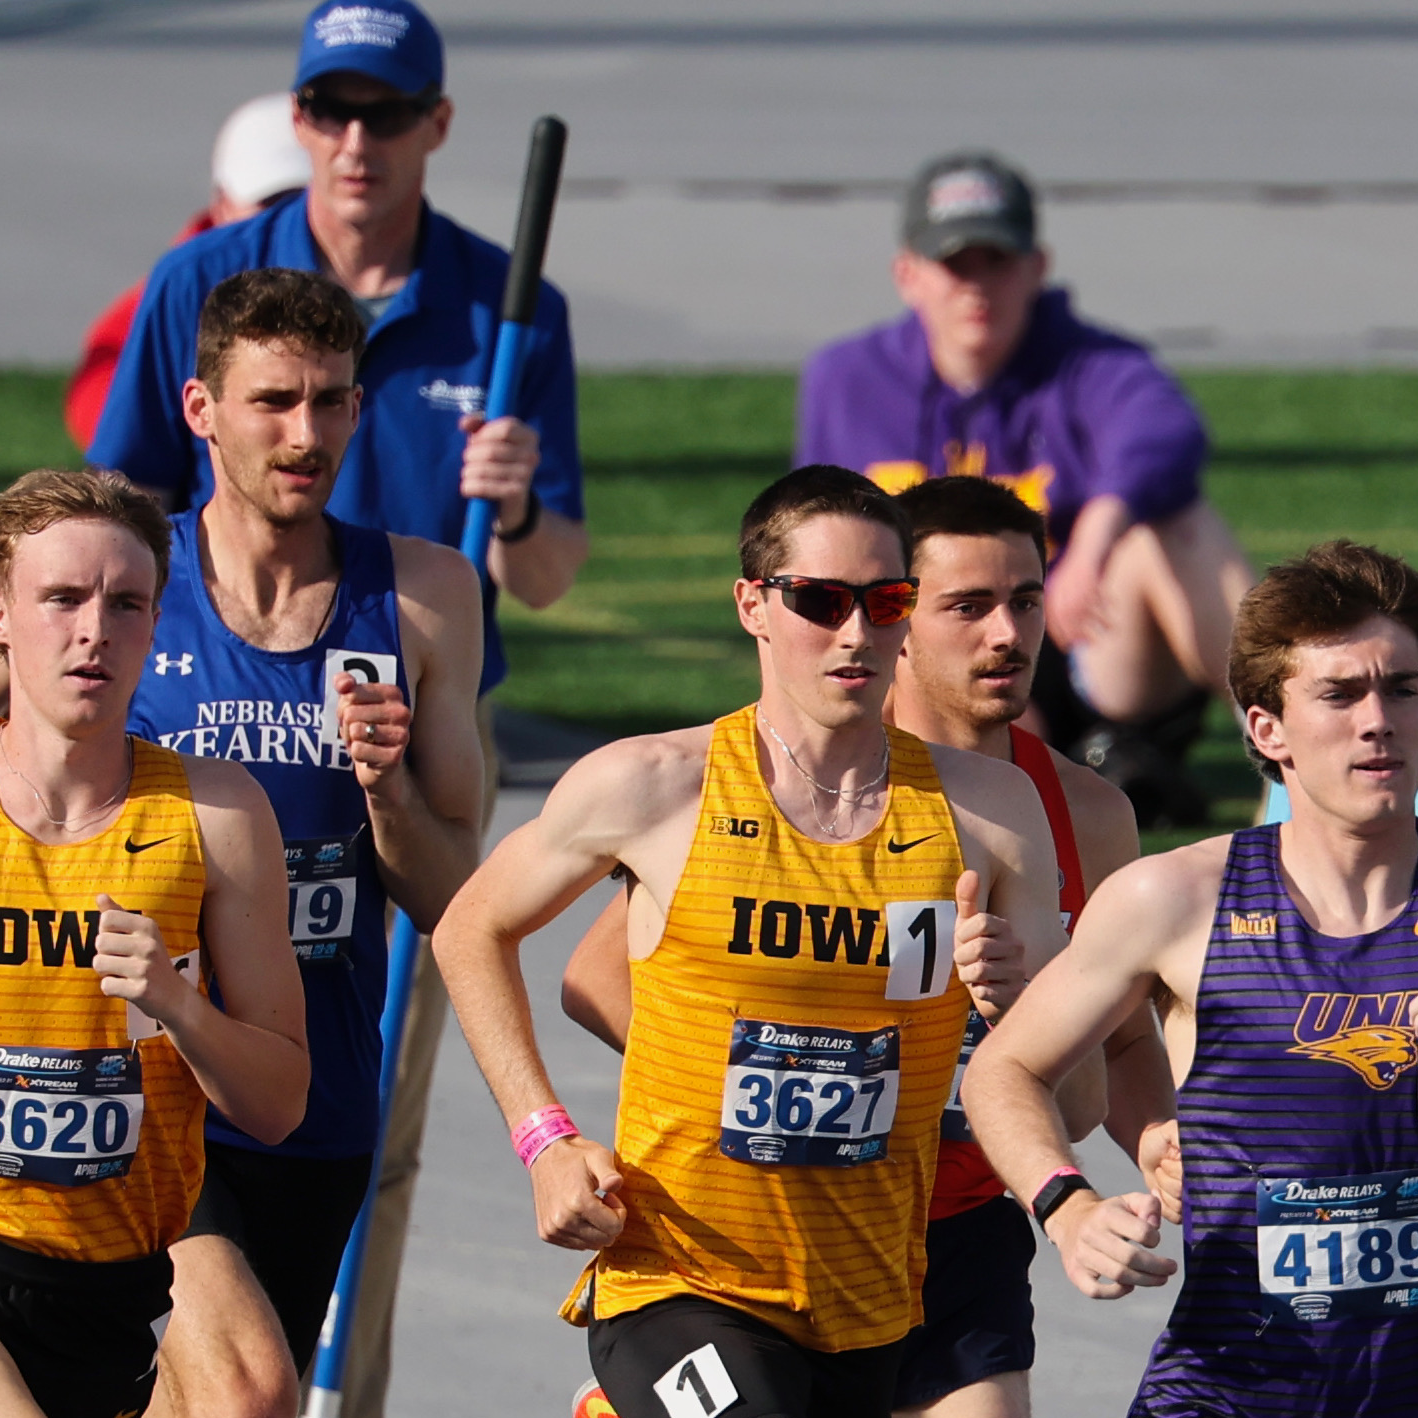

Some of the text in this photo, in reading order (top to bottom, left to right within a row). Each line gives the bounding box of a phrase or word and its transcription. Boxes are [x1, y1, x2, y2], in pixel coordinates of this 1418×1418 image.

[1231, 914, 1278, 935] VALLEY
[728, 896, 936, 994] IOW 1
[758, 1026, 809, 1047] Drake
[810, 1037, 853, 1050] RELAYS
[41, 1057, 83, 1071] RELAYS
[30, 1079, 78, 1088] XTREAM
[736, 1074, 885, 1133] 3627
[837, 1144, 862, 1156] APRIL
[75, 1164, 98, 1176] APRIL
[1285, 1182, 1382, 1200] Drake RELAYS
[1330, 1208, 1378, 1217] XTREAM
[1384, 1289, 1409, 1303] APRIL
[675, 1358, 717, 1417] 1
